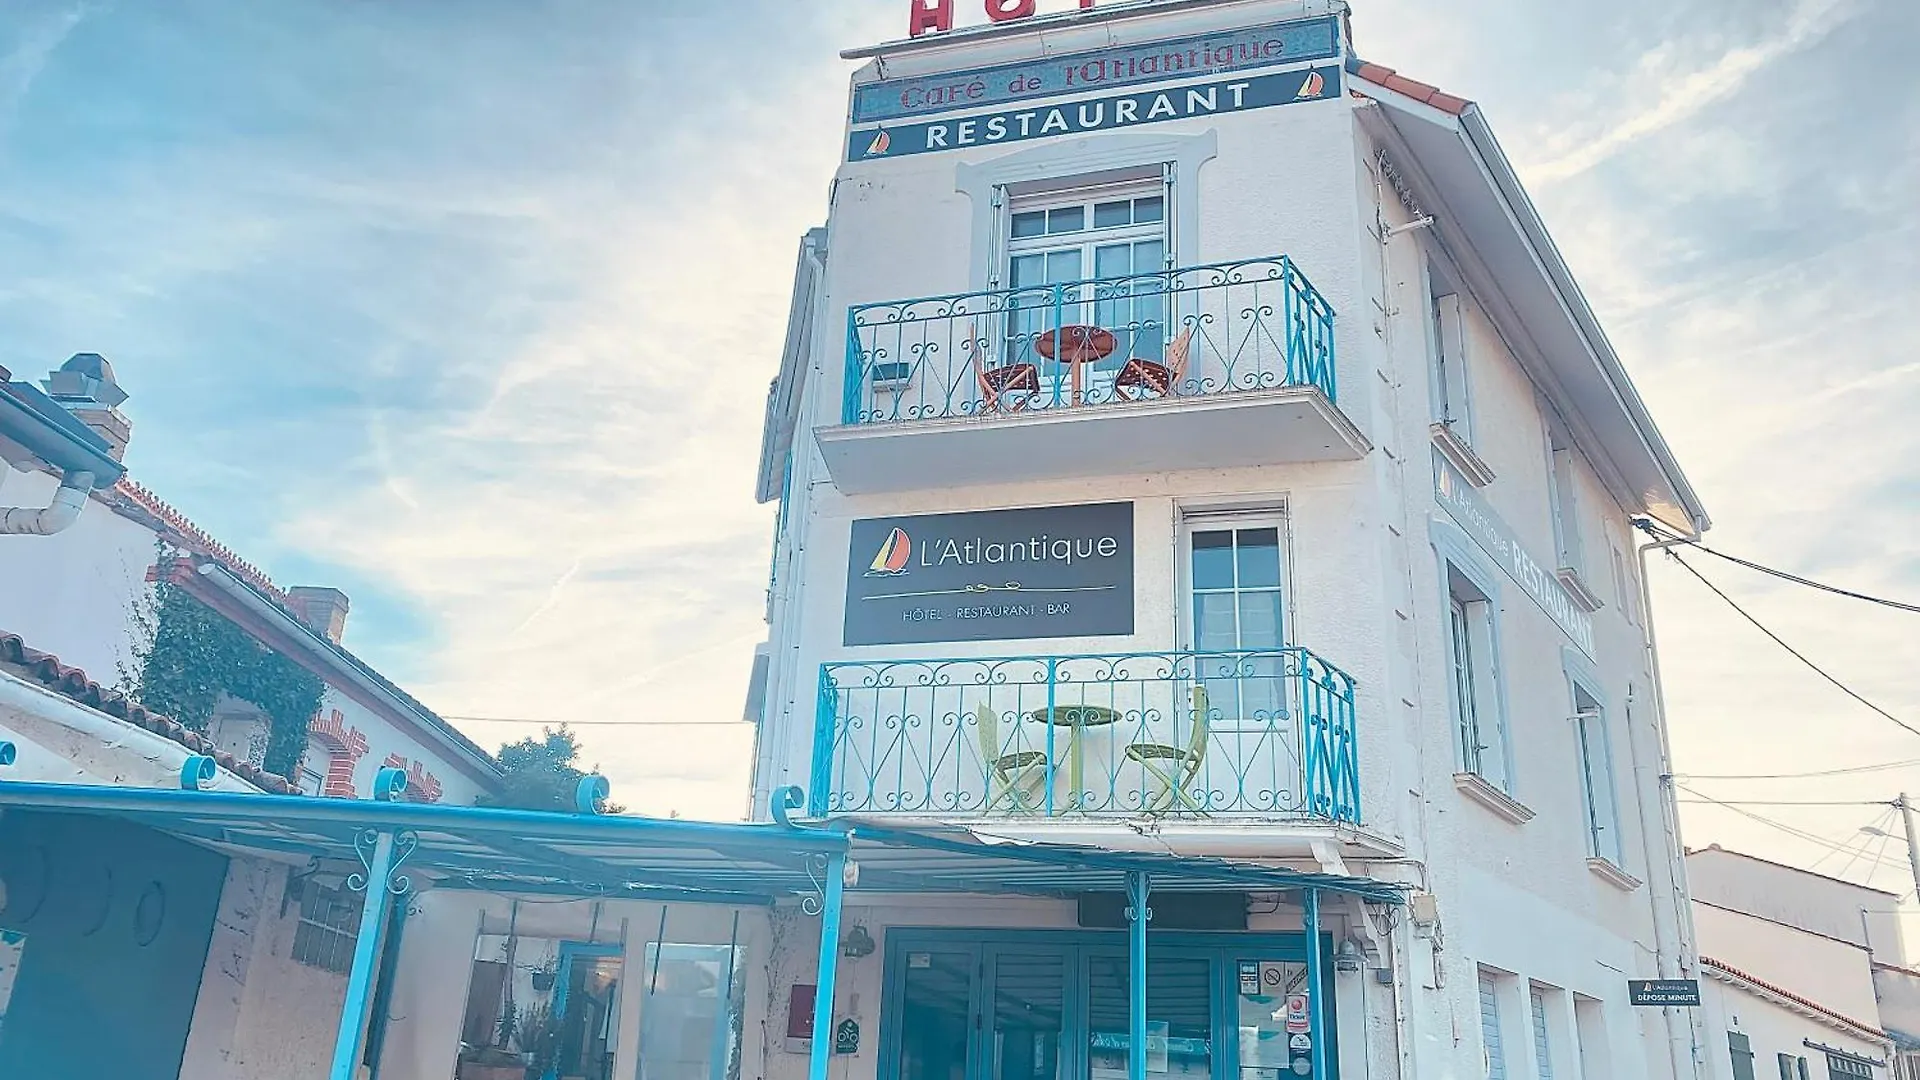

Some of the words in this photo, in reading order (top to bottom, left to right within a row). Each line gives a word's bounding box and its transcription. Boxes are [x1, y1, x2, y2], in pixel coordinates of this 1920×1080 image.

[1008, 74, 1042, 94] de
[926, 83, 1249, 149] RESTAURANT
[921, 534, 1117, 567] L'Atlantique
[903, 608, 943, 621] HÔTEL
[956, 604, 1034, 619] RESTAURANT
[1047, 602, 1070, 615] BAR
[1512, 540, 1593, 654] RESTAURANT
